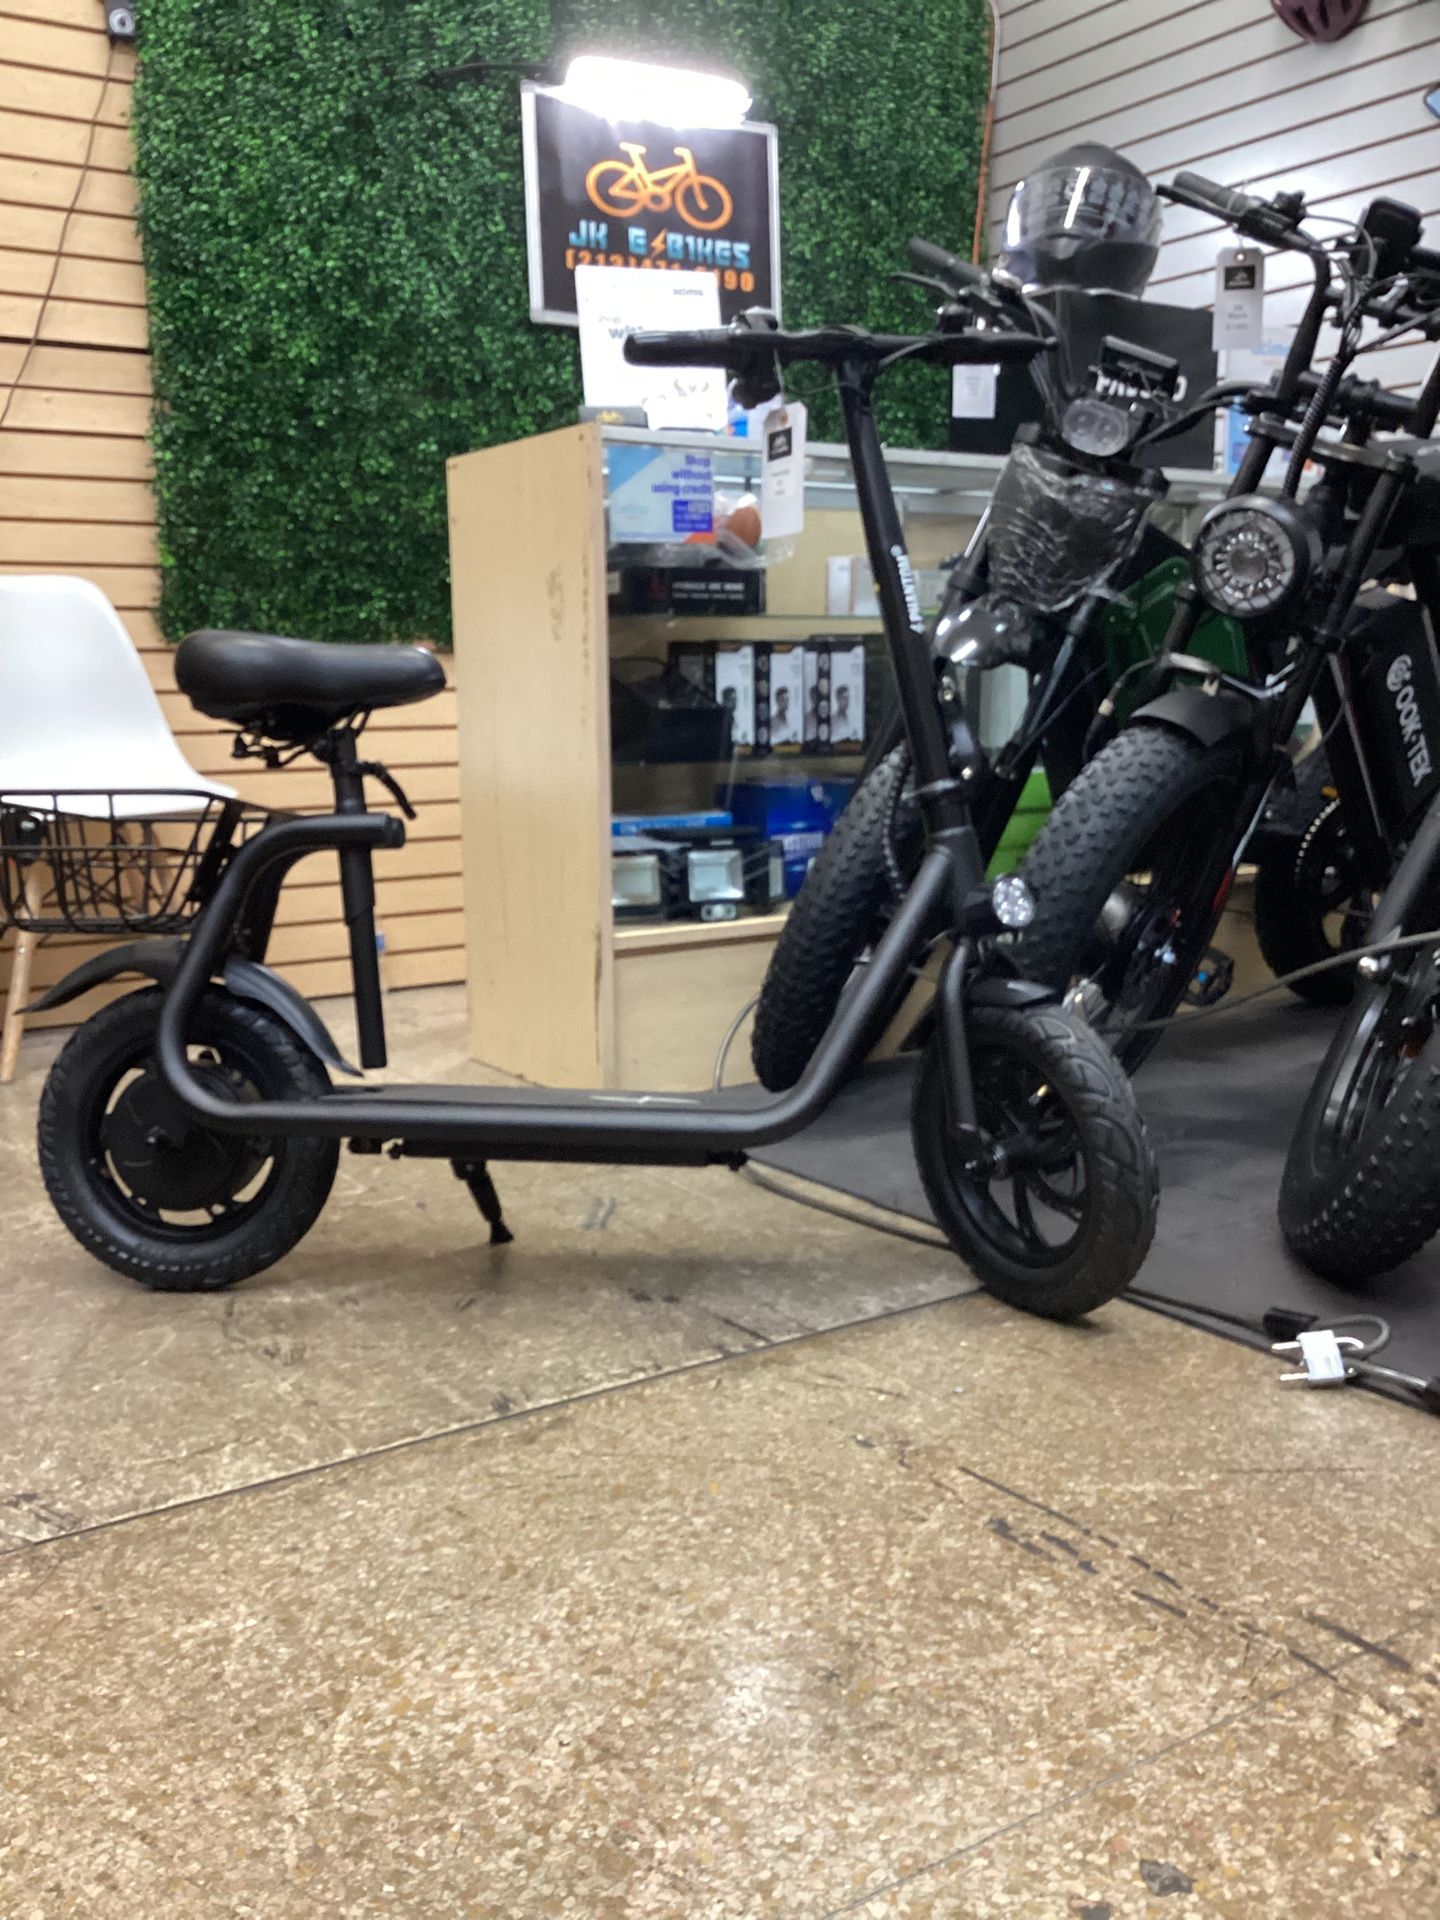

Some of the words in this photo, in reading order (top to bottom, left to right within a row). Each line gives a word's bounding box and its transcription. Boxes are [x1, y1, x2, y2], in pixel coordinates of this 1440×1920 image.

[568, 219, 608, 249] JK
[685, 454, 711, 468] Shop
[671, 469, 711, 481] without
[651, 482, 680, 497] using
[682, 484, 711, 495] credit
